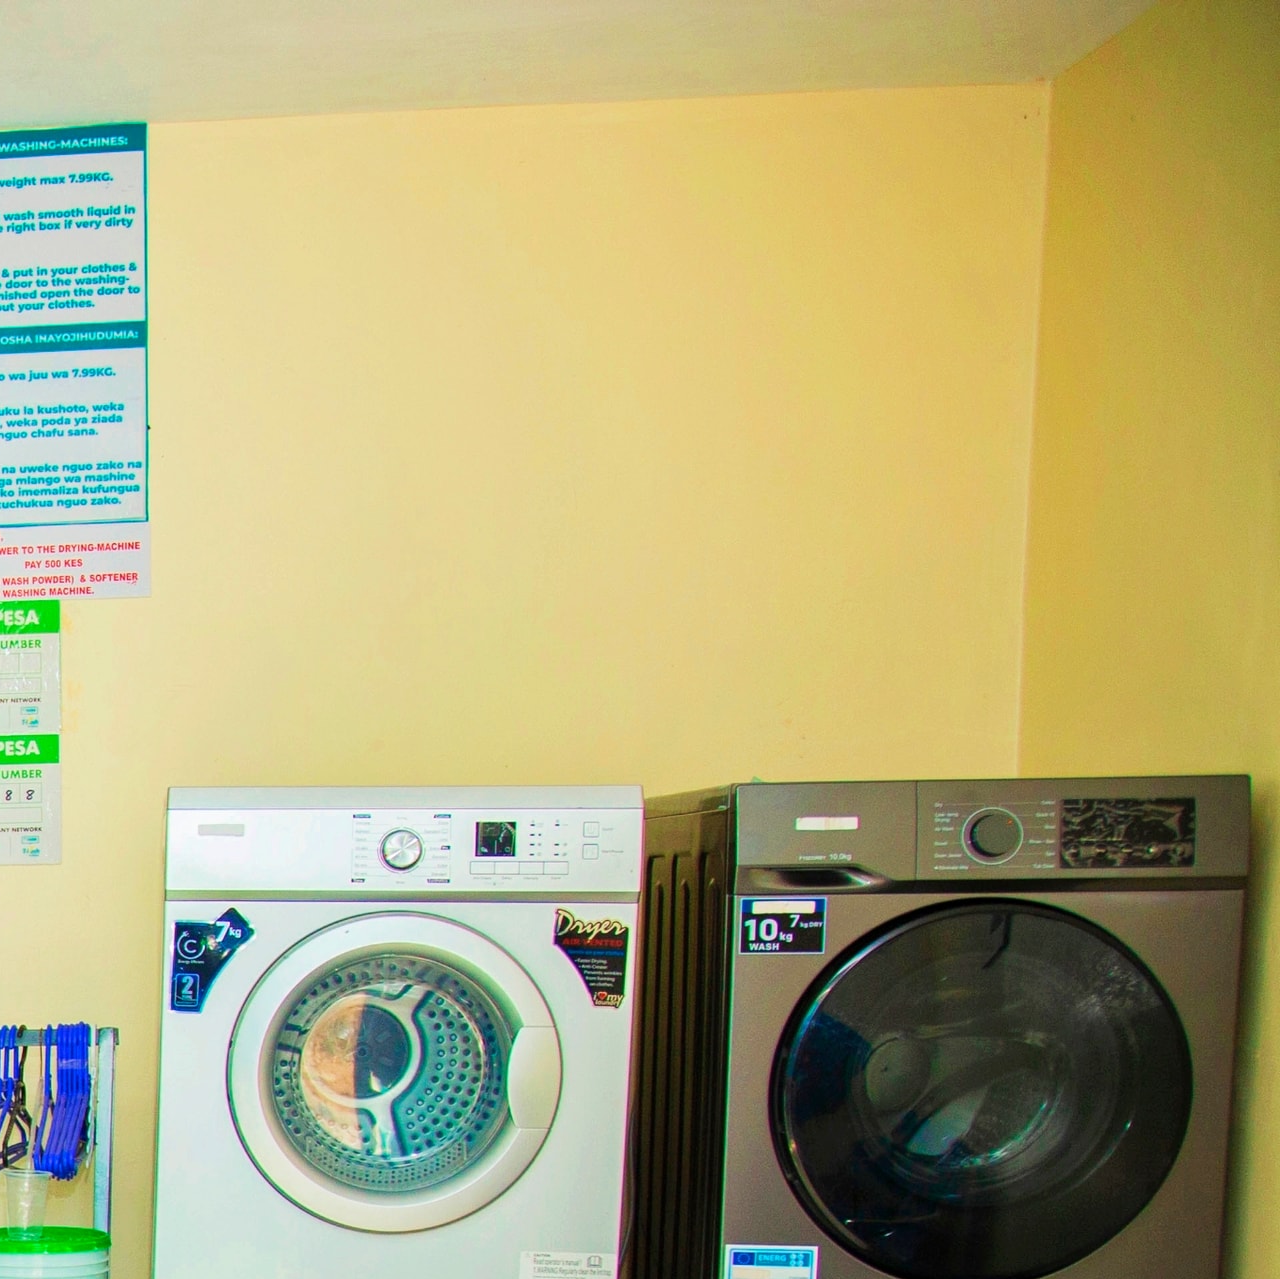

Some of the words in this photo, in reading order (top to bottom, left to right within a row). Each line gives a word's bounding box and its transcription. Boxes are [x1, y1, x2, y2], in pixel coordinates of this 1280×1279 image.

[39, 177, 65, 185] max
[68, 172, 113, 183] 7.99KG.
[3, 211, 35, 221] wash
[37, 208, 84, 219] smooth
[86, 206, 121, 218] liquid
[124, 205, 135, 214] in
[35, 330, 139, 342] INAYOJIHUDUMIA:
[29, 372, 48, 381] juu
[71, 367, 115, 377] 7.99KG.
[556, 909, 626, 943] Dryer
[749, 942, 780, 951] WASH
[758, 1254, 787, 1262] ENERG
